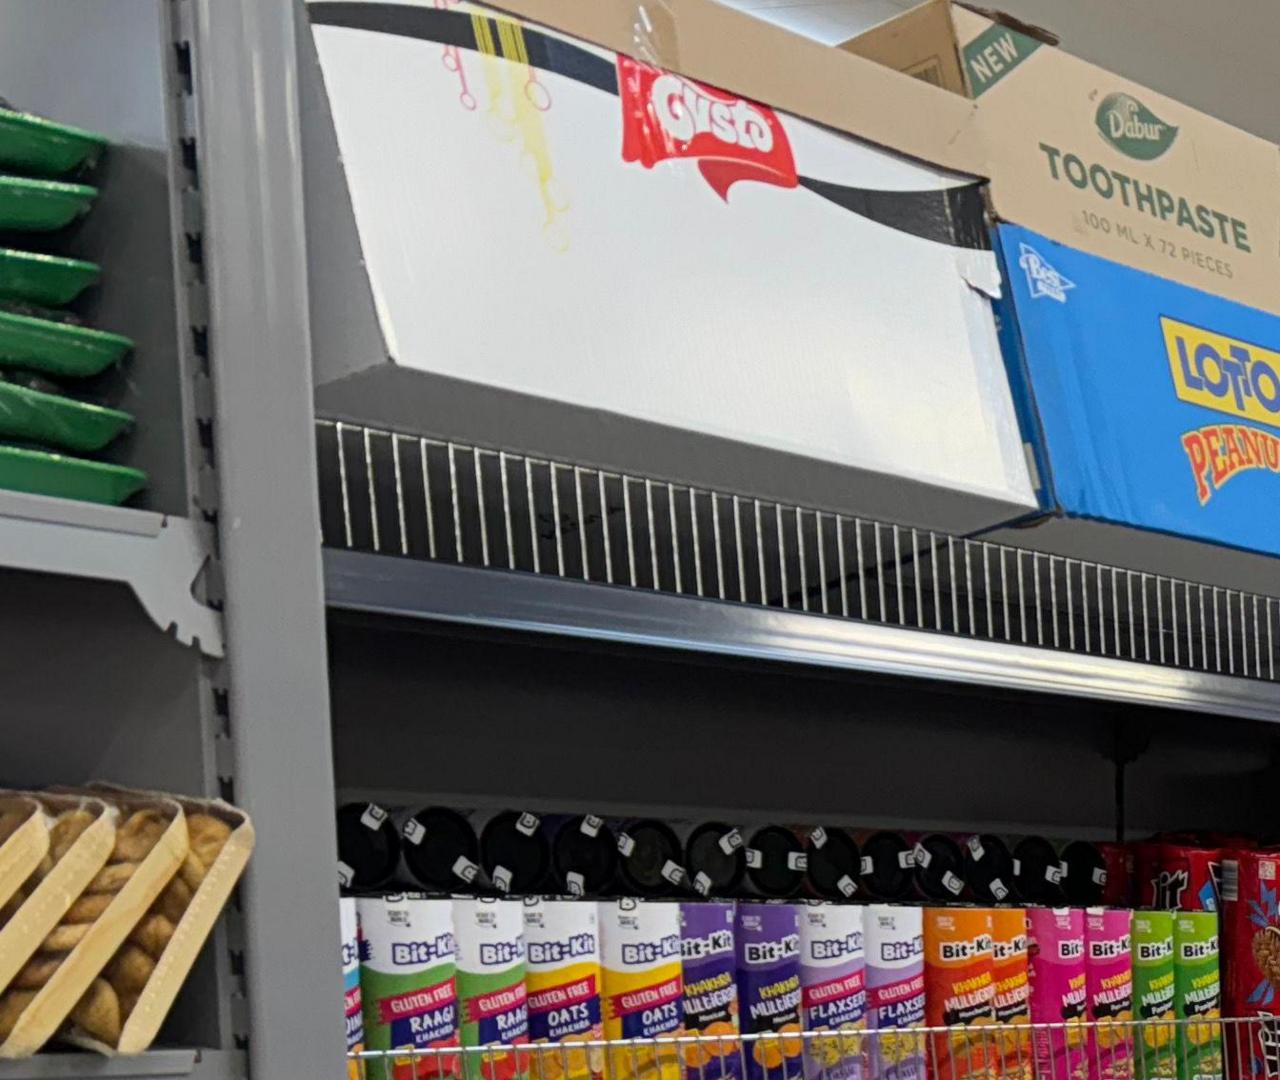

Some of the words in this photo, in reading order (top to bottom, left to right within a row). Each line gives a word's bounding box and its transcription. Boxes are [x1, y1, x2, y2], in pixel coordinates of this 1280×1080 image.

[971, 33, 1019, 83] NEW
[651, 73, 773, 153] Gusto
[1108, 106, 1164, 141] Dabur
[1039, 142, 1252, 254] TOOTHPASTE
[1082, 210, 1111, 234] 100
[1116, 223, 1139, 246] ML
[1143, 233, 1155, 248] X
[1159, 238, 1177, 258] 72
[1182, 246, 1233, 279] PIECES
[527, 932, 595, 965] Bit-Kit
[390, 990, 433, 1014] GLUTEN
[432, 983, 453, 1001] FREE
[478, 992, 513, 1012] GLUTEN
[529, 991, 565, 1009] GLUTEN
[567, 982, 590, 1001] FREE
[620, 990, 657, 1009] GLUTEN
[658, 981, 678, 1000] FREE
[808, 981, 844, 1001] GLUTEN
[877, 983, 909, 1001] GLUTEN
[408, 1009, 455, 1033] RAAGI
[547, 1002, 590, 1026] OATS
[641, 1002, 678, 1026] OATS
